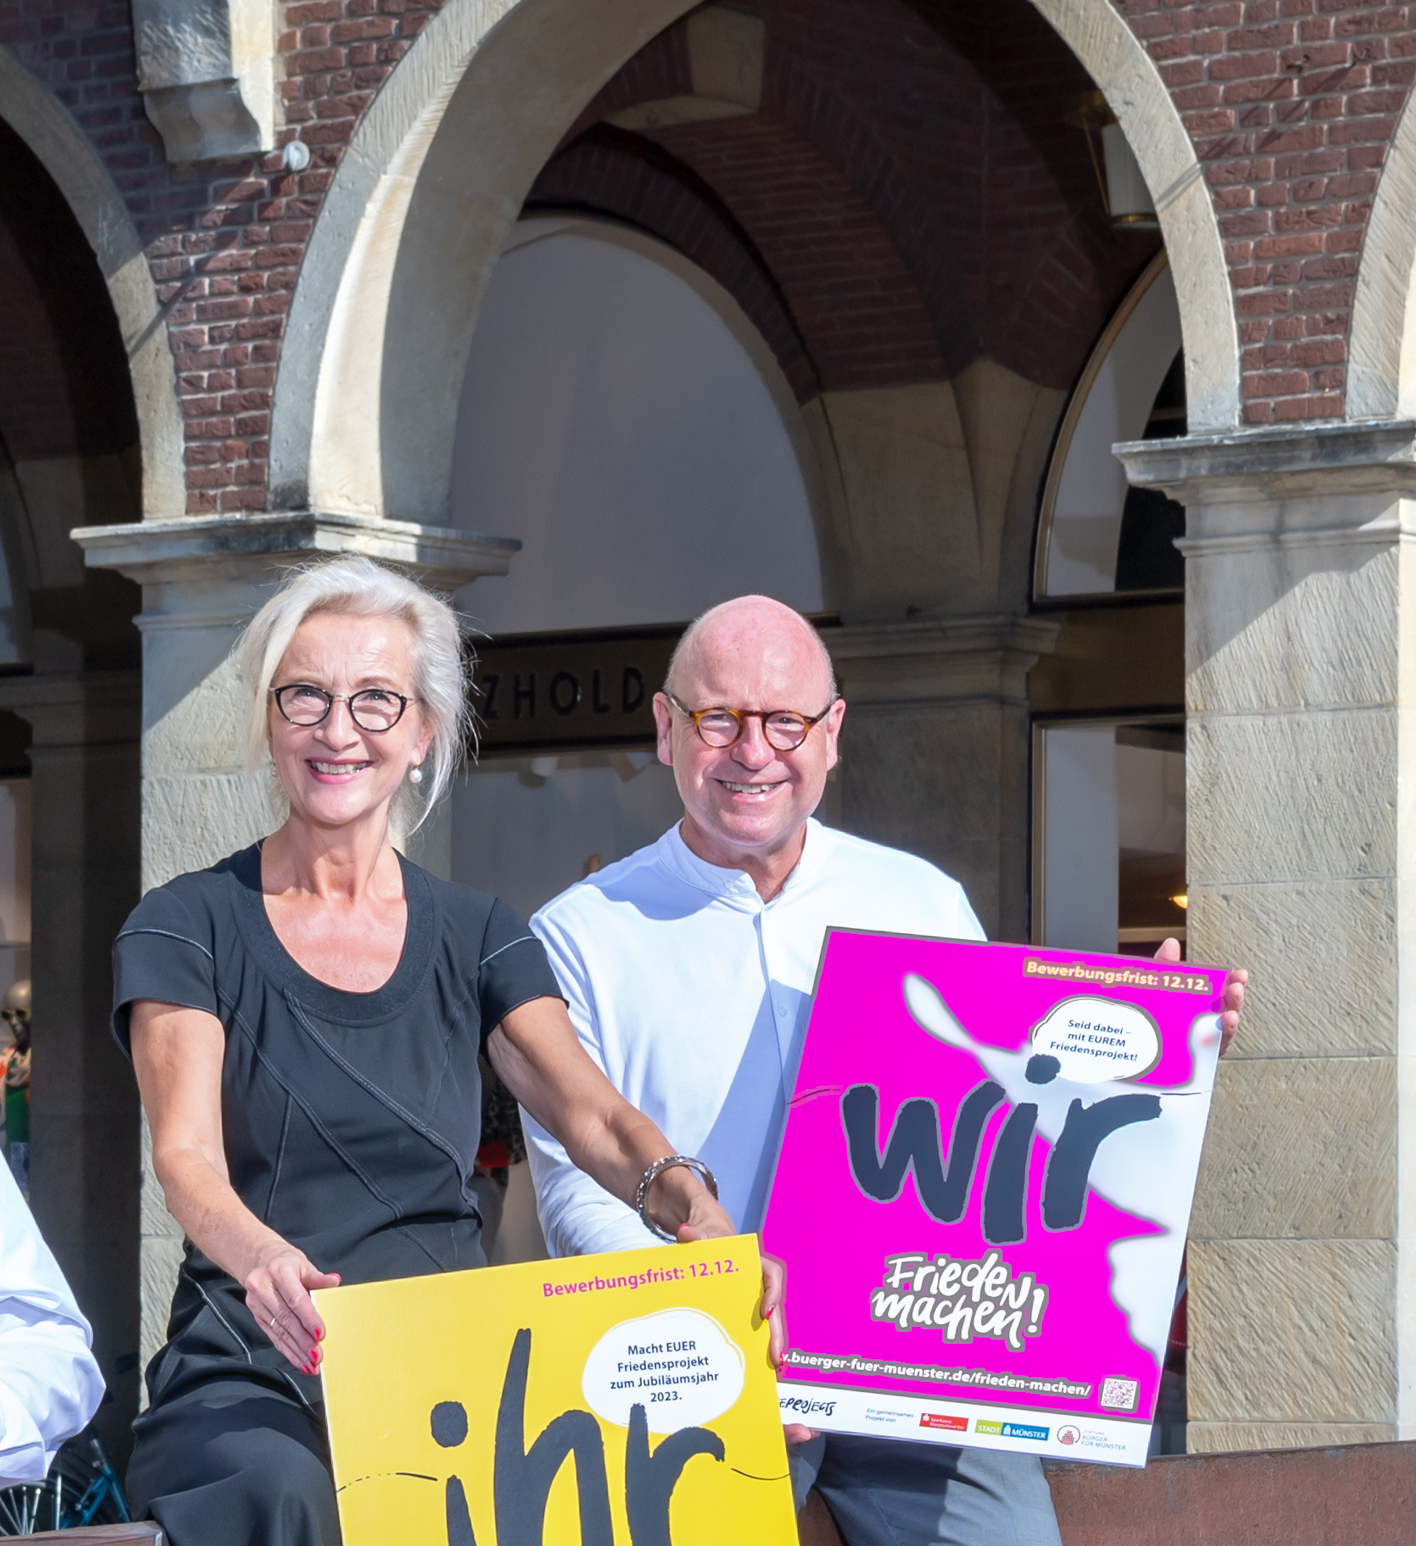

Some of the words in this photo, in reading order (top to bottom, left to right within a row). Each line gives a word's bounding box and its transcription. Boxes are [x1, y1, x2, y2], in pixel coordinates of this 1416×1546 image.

[1027, 961, 1158, 985] Bewerbungsfrist:
[1162, 976, 1209, 991] 12.12.
[1068, 1019, 1091, 1030] Seid
[1093, 1023, 1123, 1034] dabei
[1067, 1033, 1085, 1042] mit
[1088, 1036, 1126, 1047] EUREM
[1050, 1041, 1138, 1062] Friedensprojekt!
[843, 1054, 1162, 1243] wir
[542, 1266, 685, 1298] Bewerbungsfrist:
[688, 1259, 739, 1279] 12.12.
[871, 1288, 1045, 1349] machen!
[627, 1343, 663, 1356] Macht
[666, 1340, 697, 1352] EUER
[617, 1356, 709, 1374] Friedensprojekt
[610, 1379, 635, 1390] zum
[637, 1372, 719, 1388] Jubiläumsjahr
[650, 1391, 682, 1402] 2023.
[978, 1425, 1001, 1434] STADT
[1011, 1428, 1046, 1440] MÜNSTER
[1095, 1441, 1126, 1451] MÜNSTER
